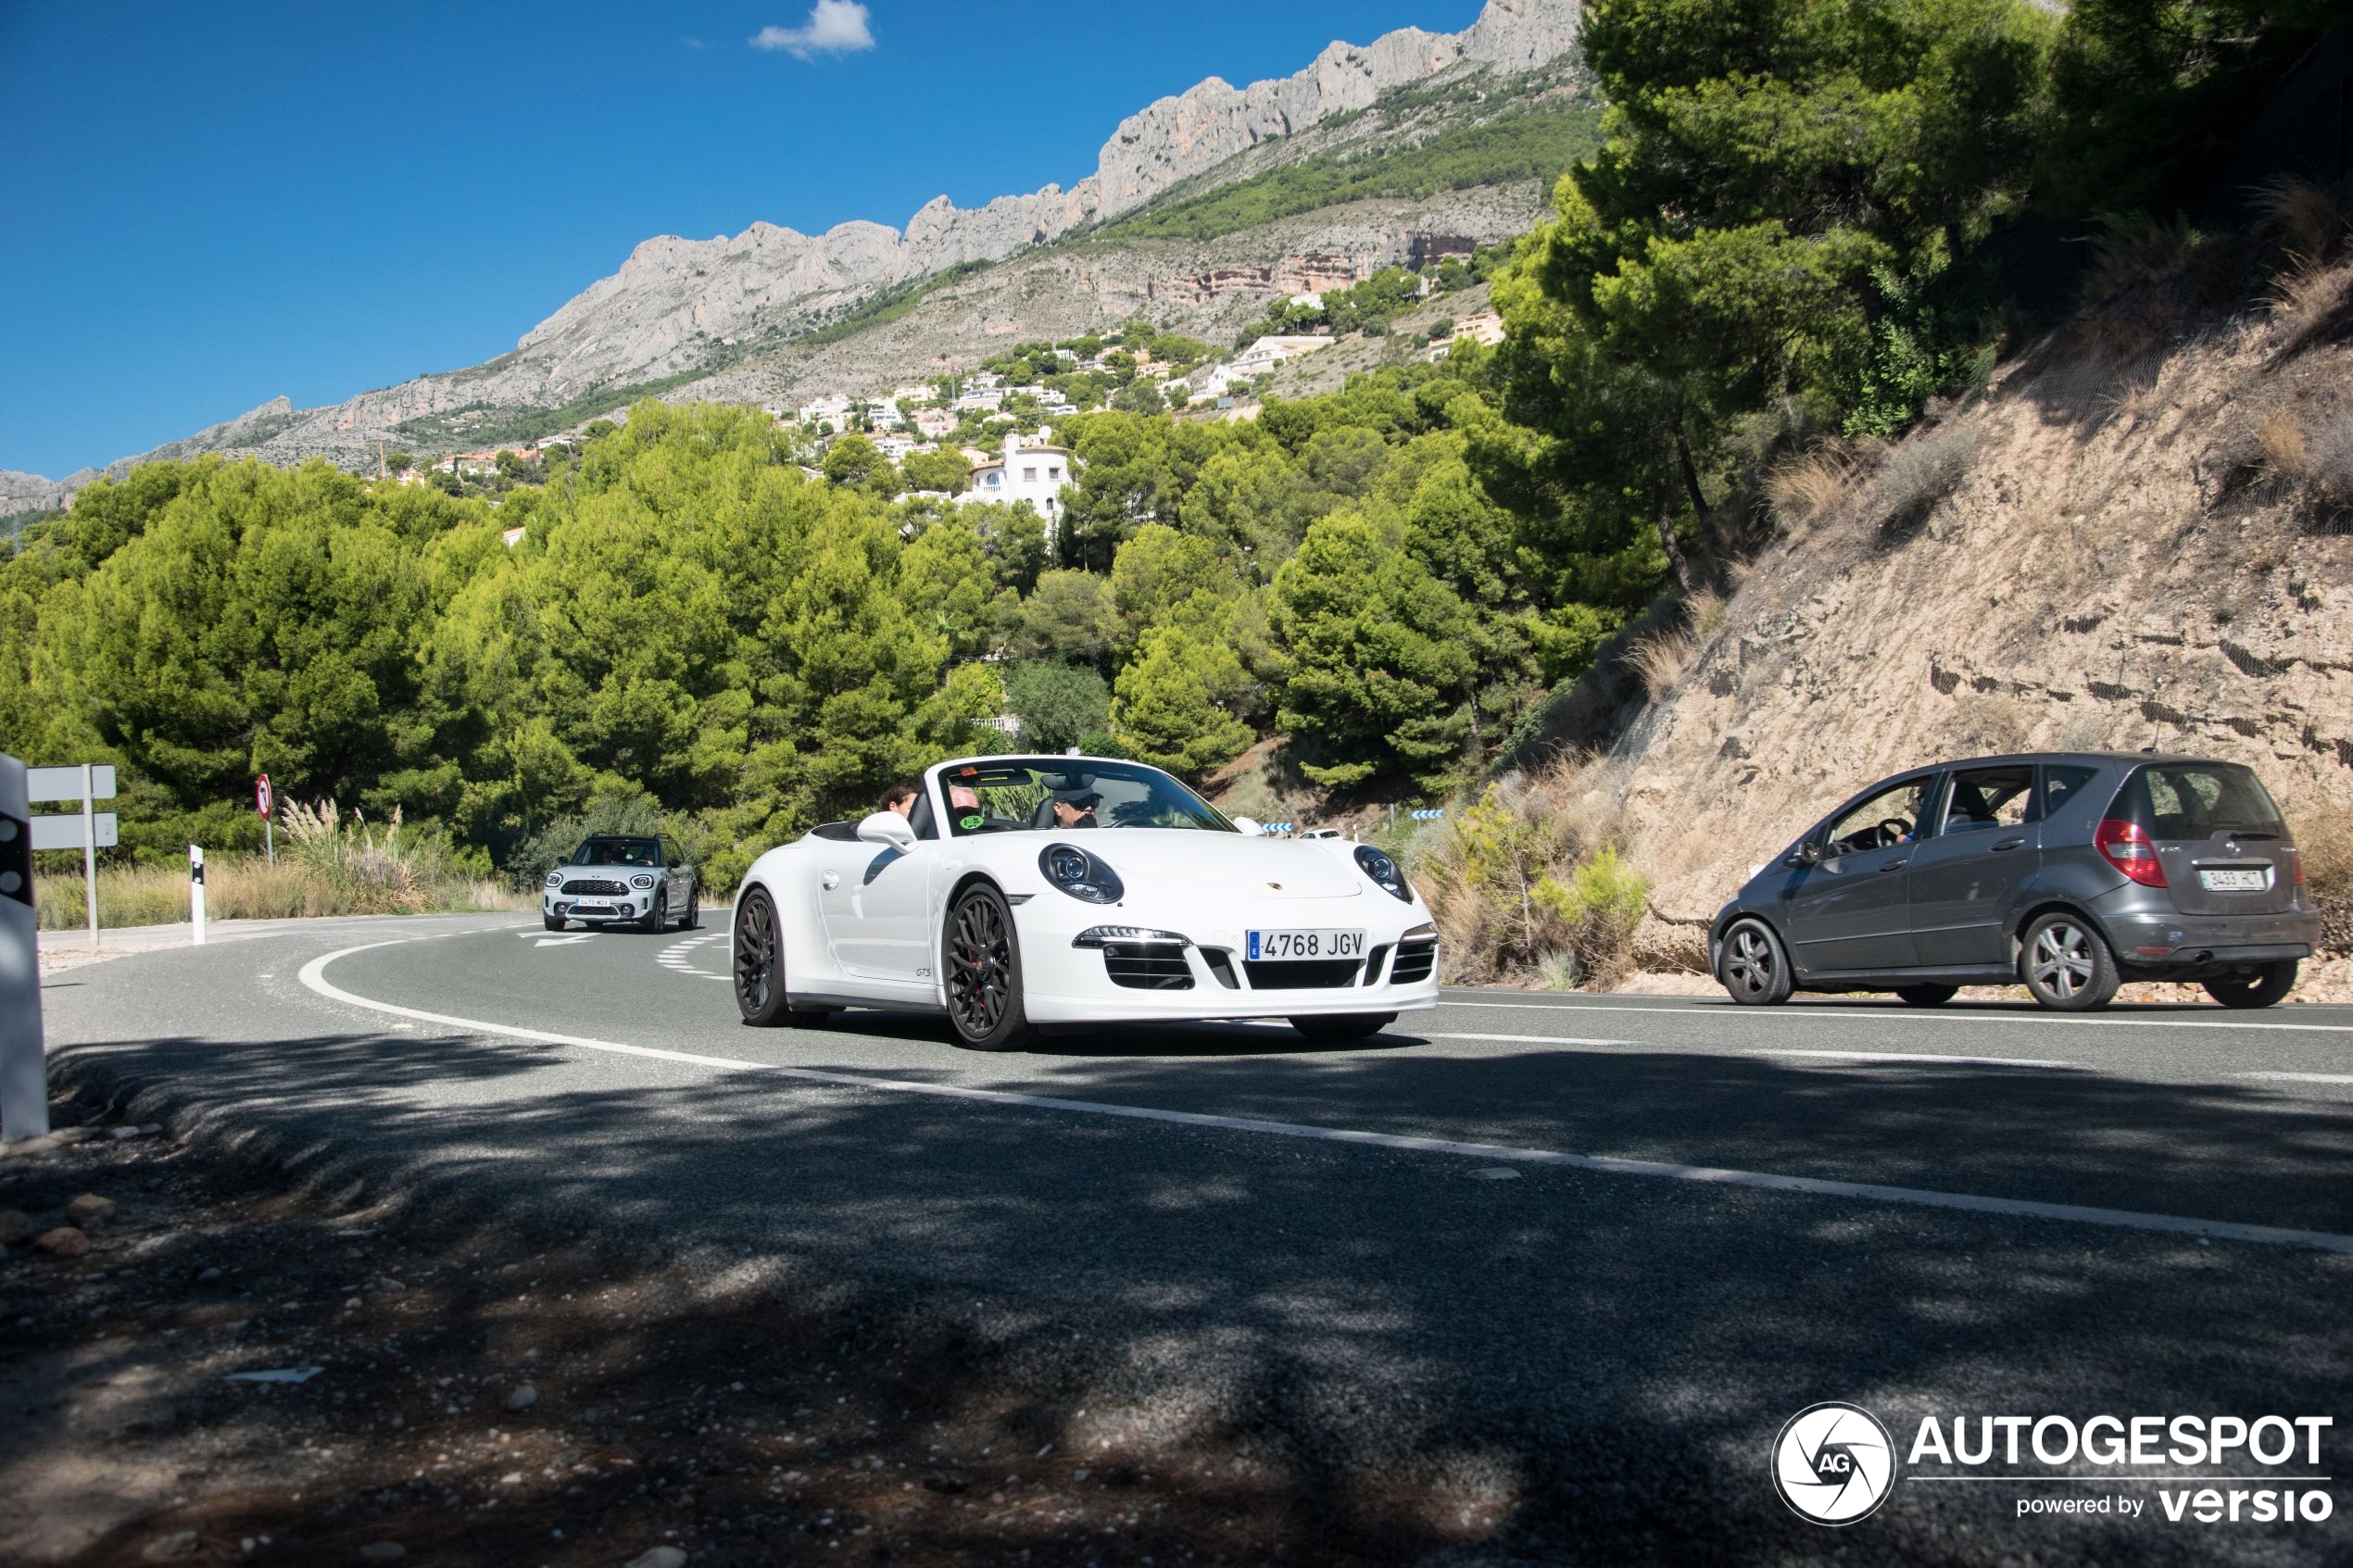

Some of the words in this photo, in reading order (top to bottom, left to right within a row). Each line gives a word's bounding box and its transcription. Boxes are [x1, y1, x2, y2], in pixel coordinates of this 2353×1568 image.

[1265, 935, 1318, 957] 4768
[1327, 934, 1363, 955] JGV
[916, 968, 931, 977] GTS
